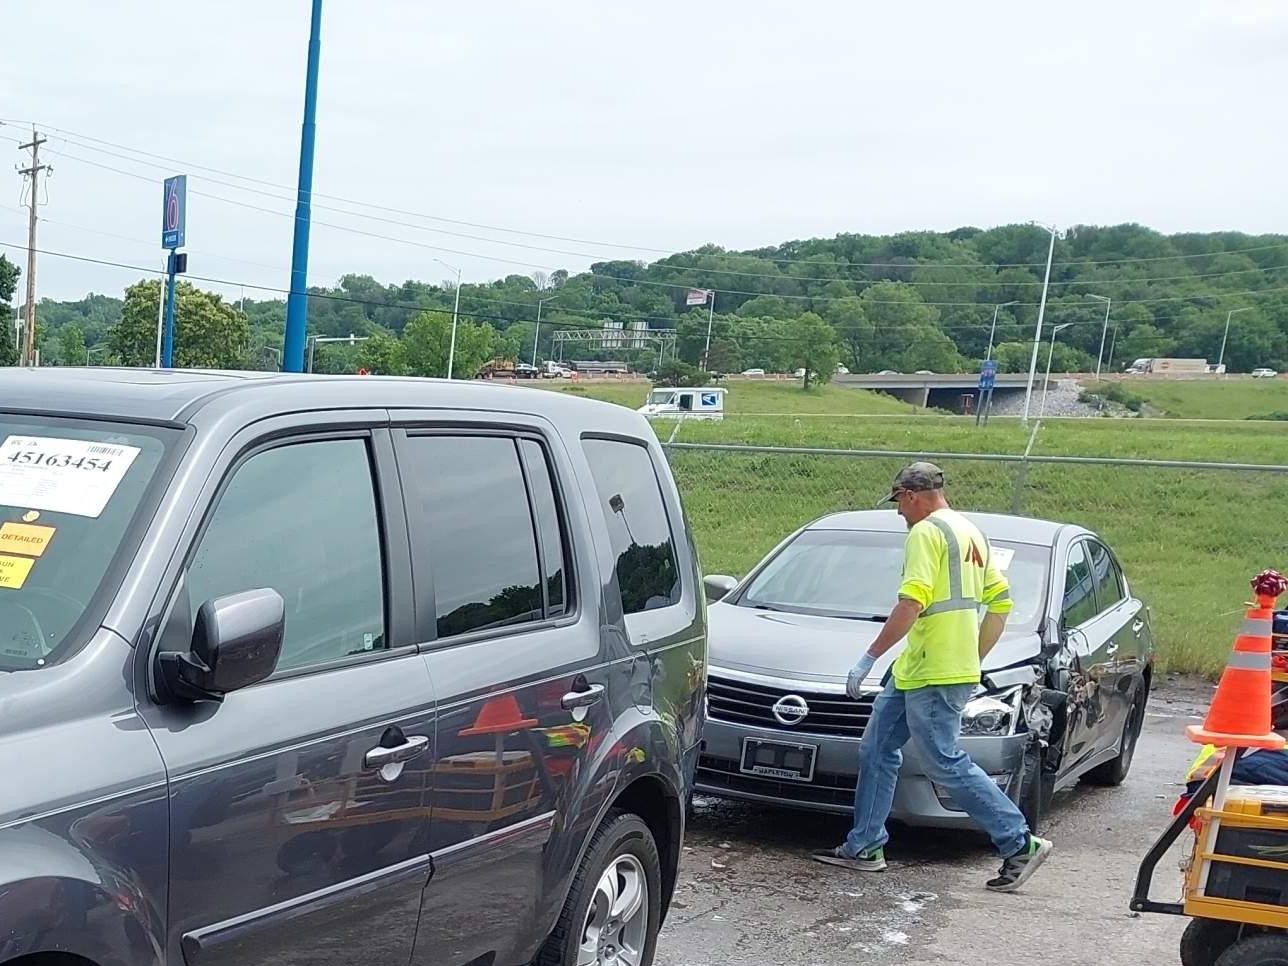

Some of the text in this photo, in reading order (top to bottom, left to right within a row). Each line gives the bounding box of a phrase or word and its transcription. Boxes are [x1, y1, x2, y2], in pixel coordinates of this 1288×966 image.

[7, 451, 113, 473] 45163454
[1, 533, 44, 544] DETAILED
[775, 705, 807, 714] NISSAN
